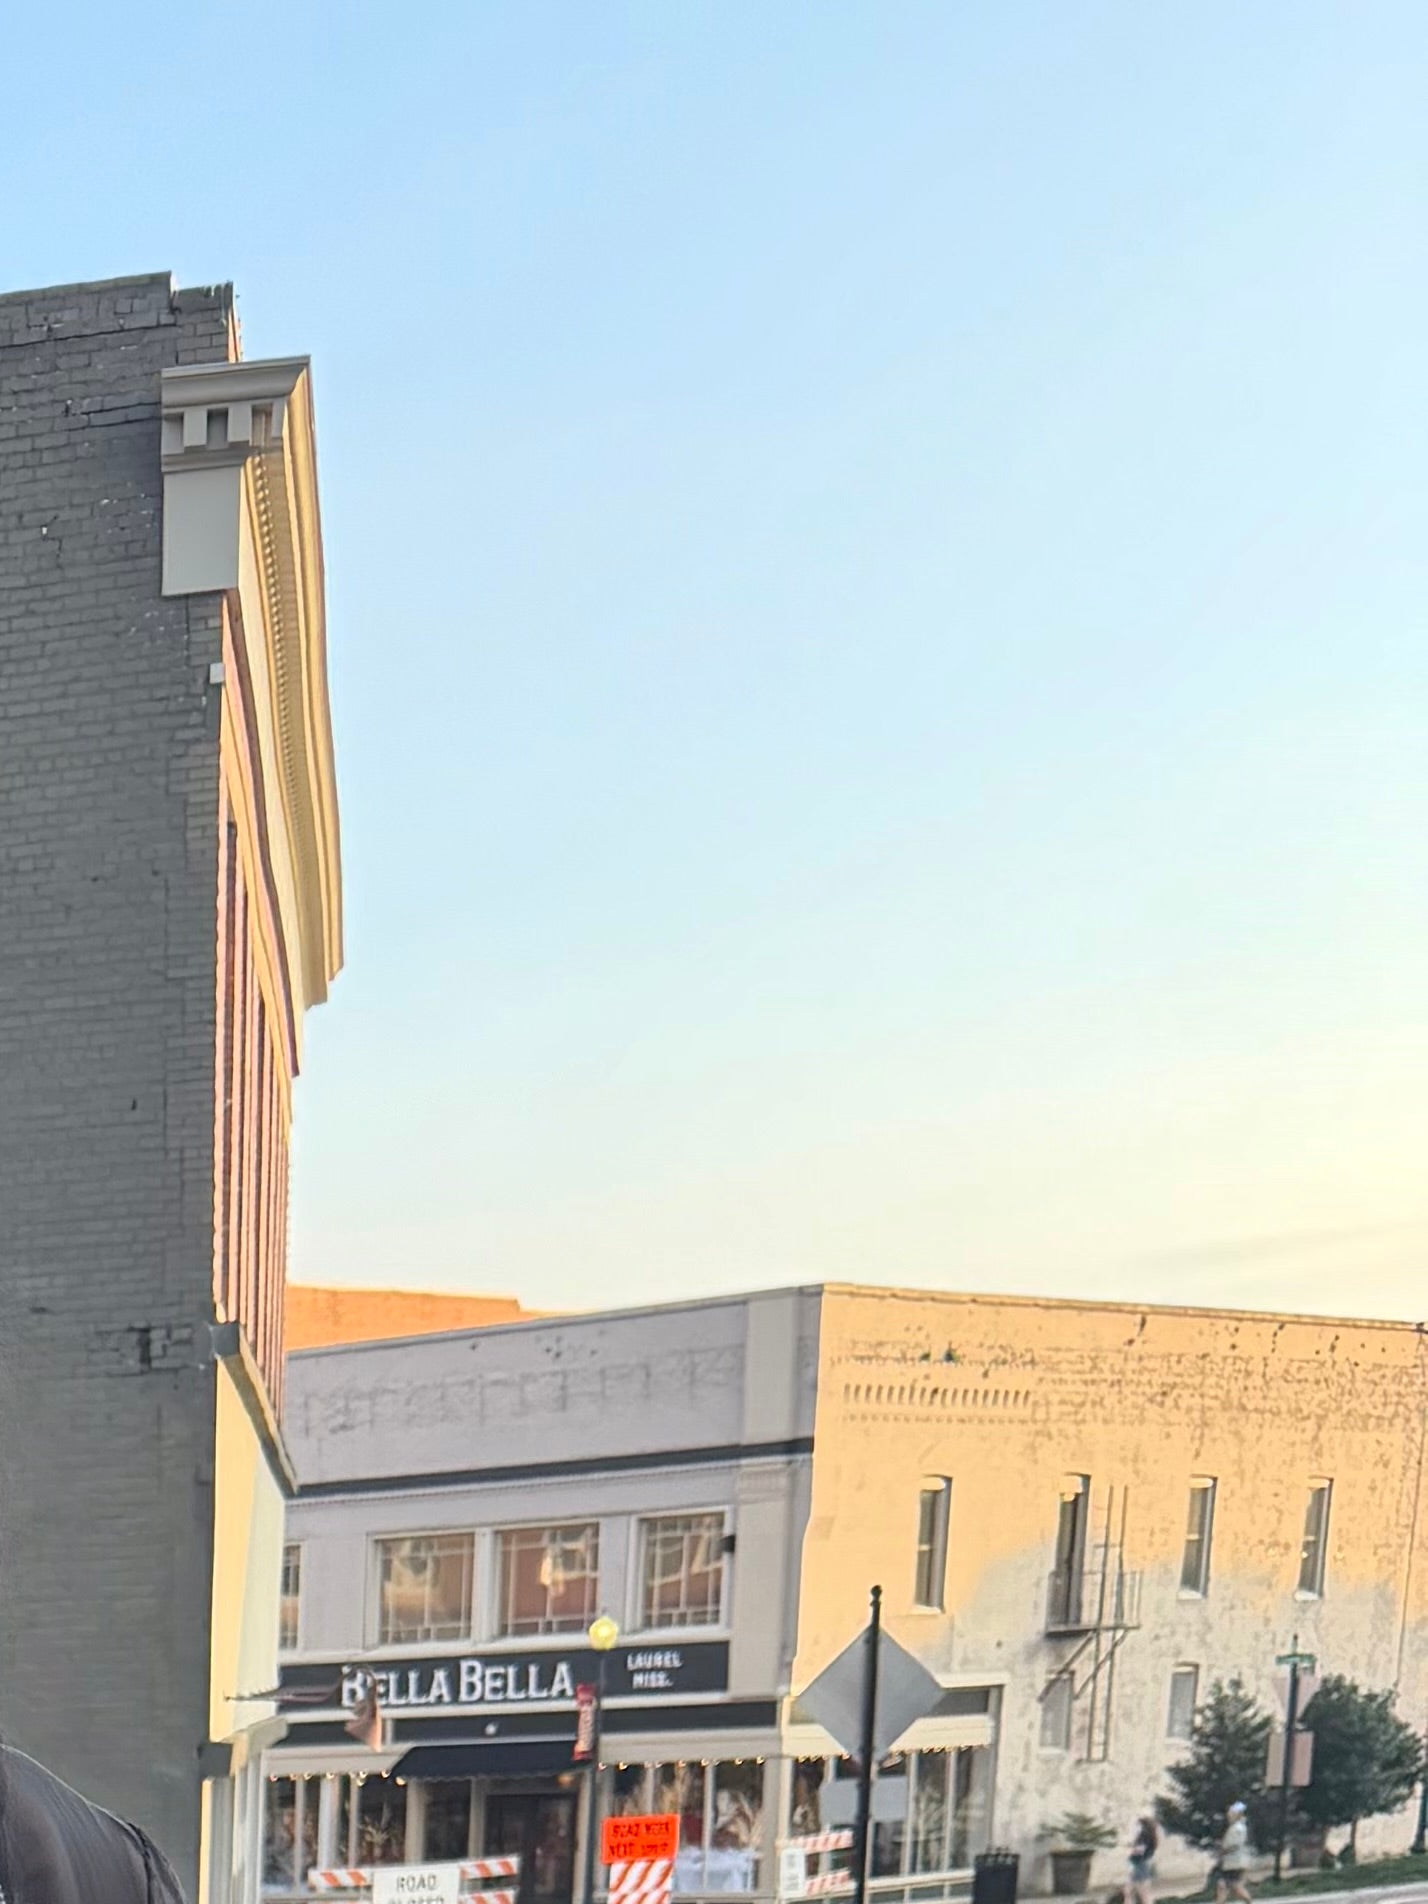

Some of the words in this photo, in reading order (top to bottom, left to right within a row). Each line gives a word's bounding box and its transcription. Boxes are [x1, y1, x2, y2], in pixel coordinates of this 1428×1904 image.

[626, 1650, 683, 1671] LAUREL
[341, 1665, 452, 1707] BELLA
[459, 1659, 574, 1702] BELLA
[396, 1873, 437, 1893] ROAD
